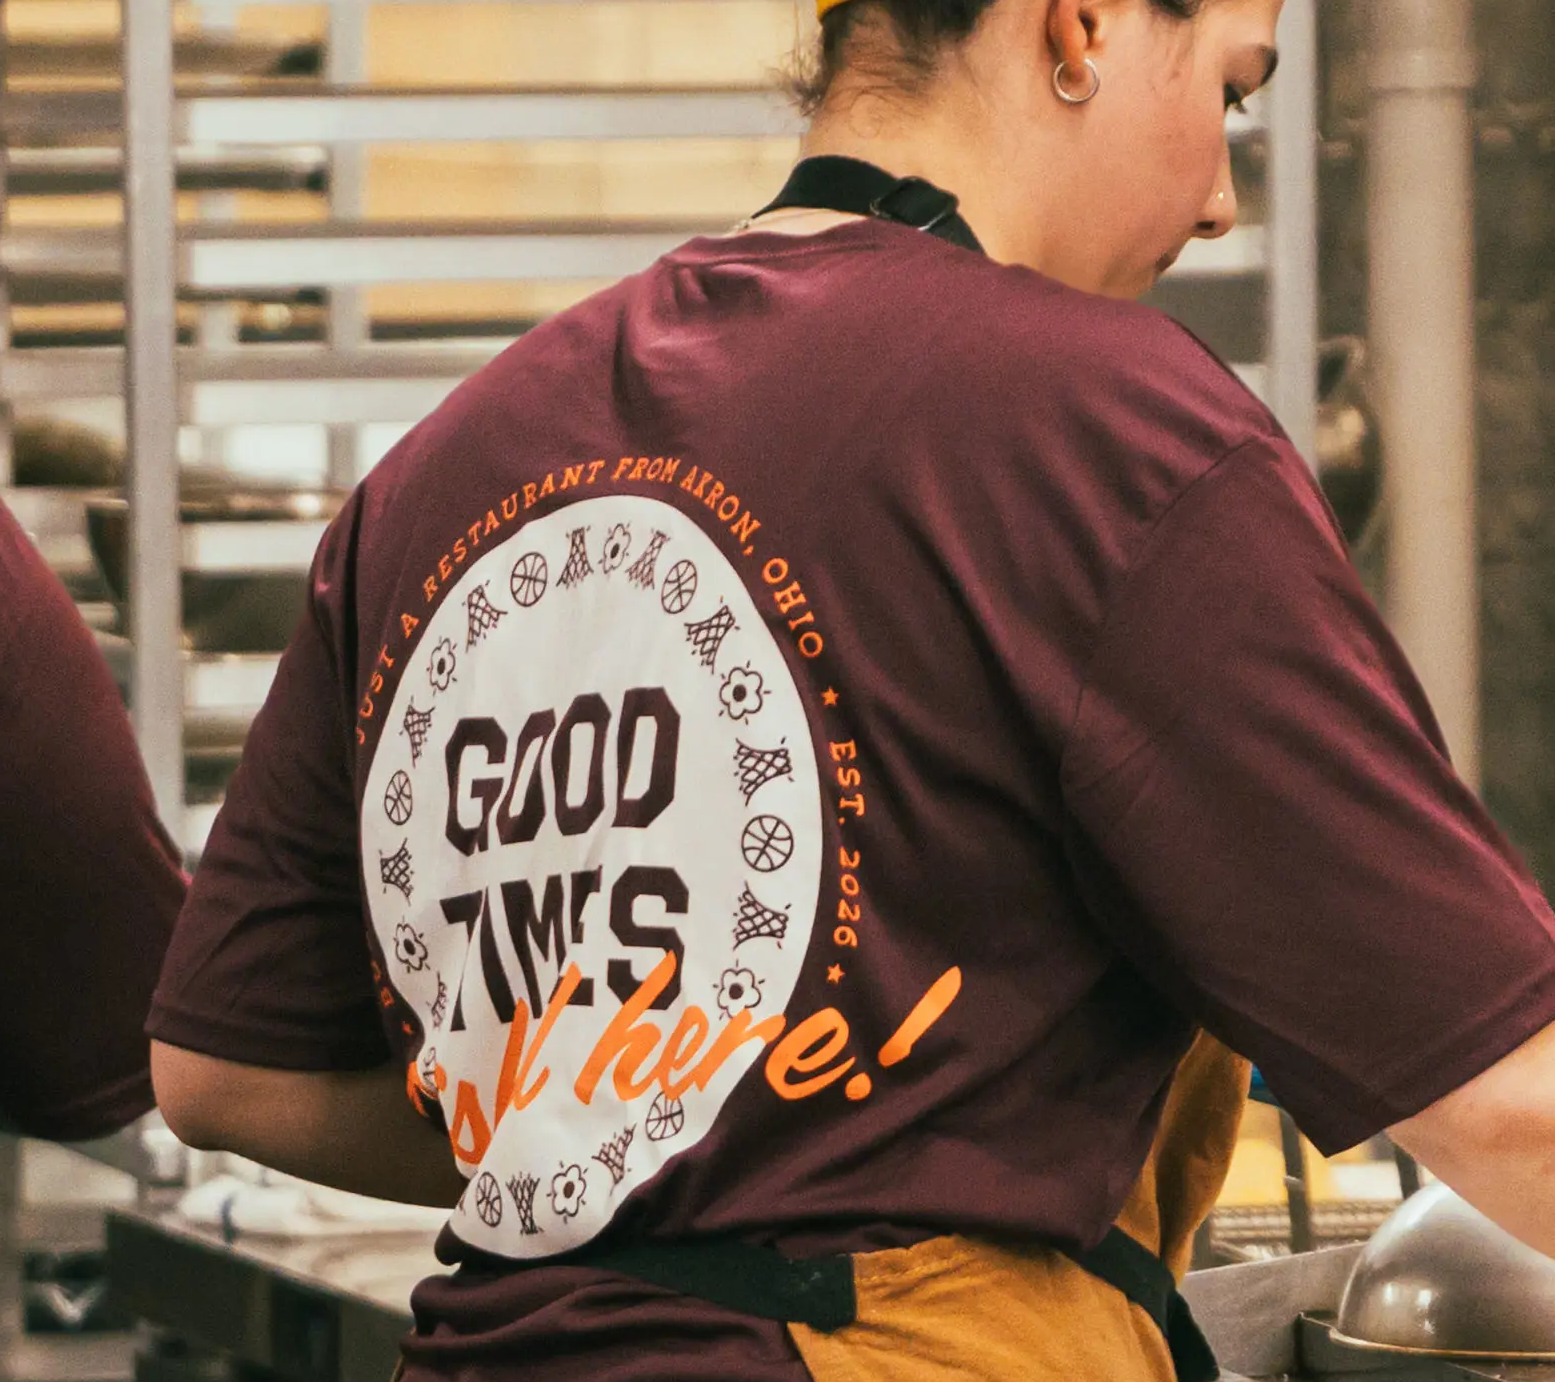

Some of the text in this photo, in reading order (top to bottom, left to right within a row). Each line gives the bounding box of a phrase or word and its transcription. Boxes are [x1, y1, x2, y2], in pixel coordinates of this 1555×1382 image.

[356, 455, 824, 745] JUST A RESTAURANT FROM AKRON, OHIO
[444, 686, 681, 859] GOOD
[828, 738, 866, 949] EST. 2026
[572, 950, 963, 1106] here!
